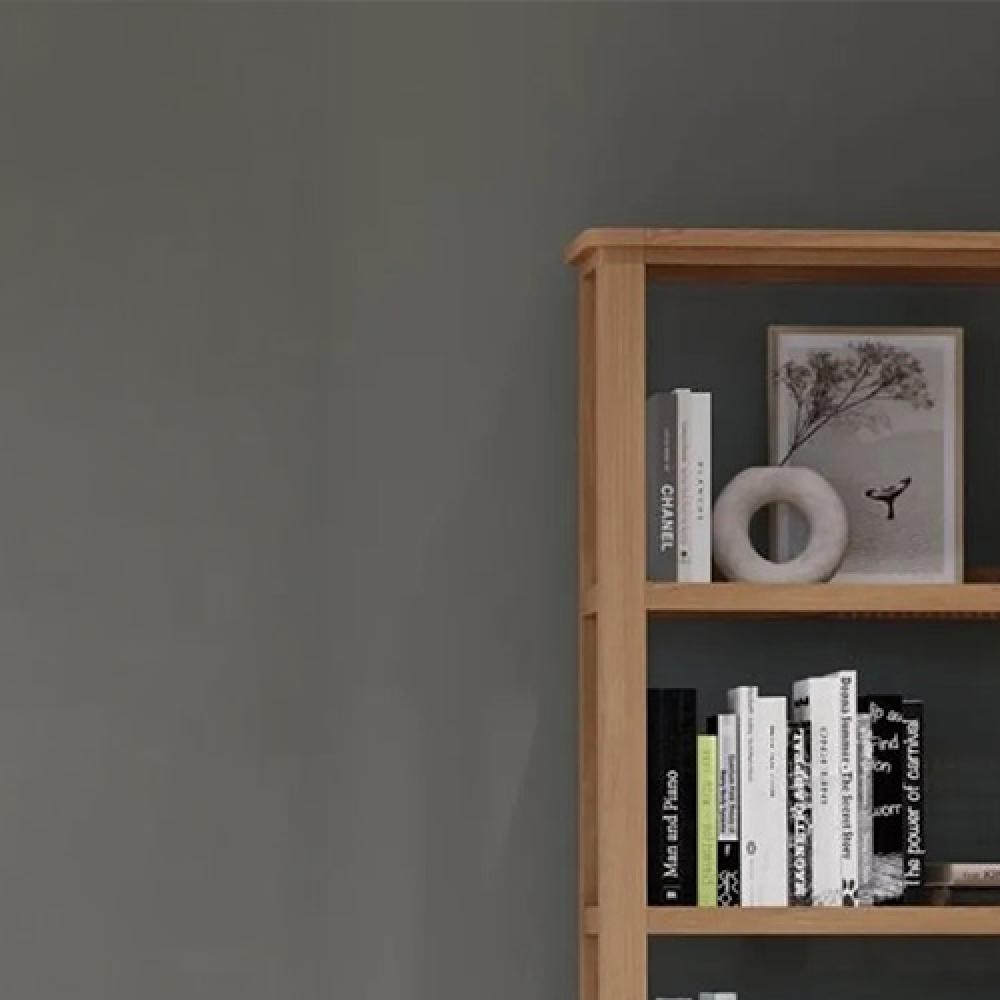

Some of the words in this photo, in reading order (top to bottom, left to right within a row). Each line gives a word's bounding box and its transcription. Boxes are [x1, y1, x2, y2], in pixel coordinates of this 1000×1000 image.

[660, 484, 675, 552] CHANEL
[900, 719, 920, 780] carnival
[663, 769, 679, 811] Piano
[841, 772, 853, 791] The
[901, 782, 920, 802] of
[662, 815, 679, 841] and
[908, 805, 926, 855] power
[663, 846, 679, 878] Man
[903, 859, 920, 886] The
